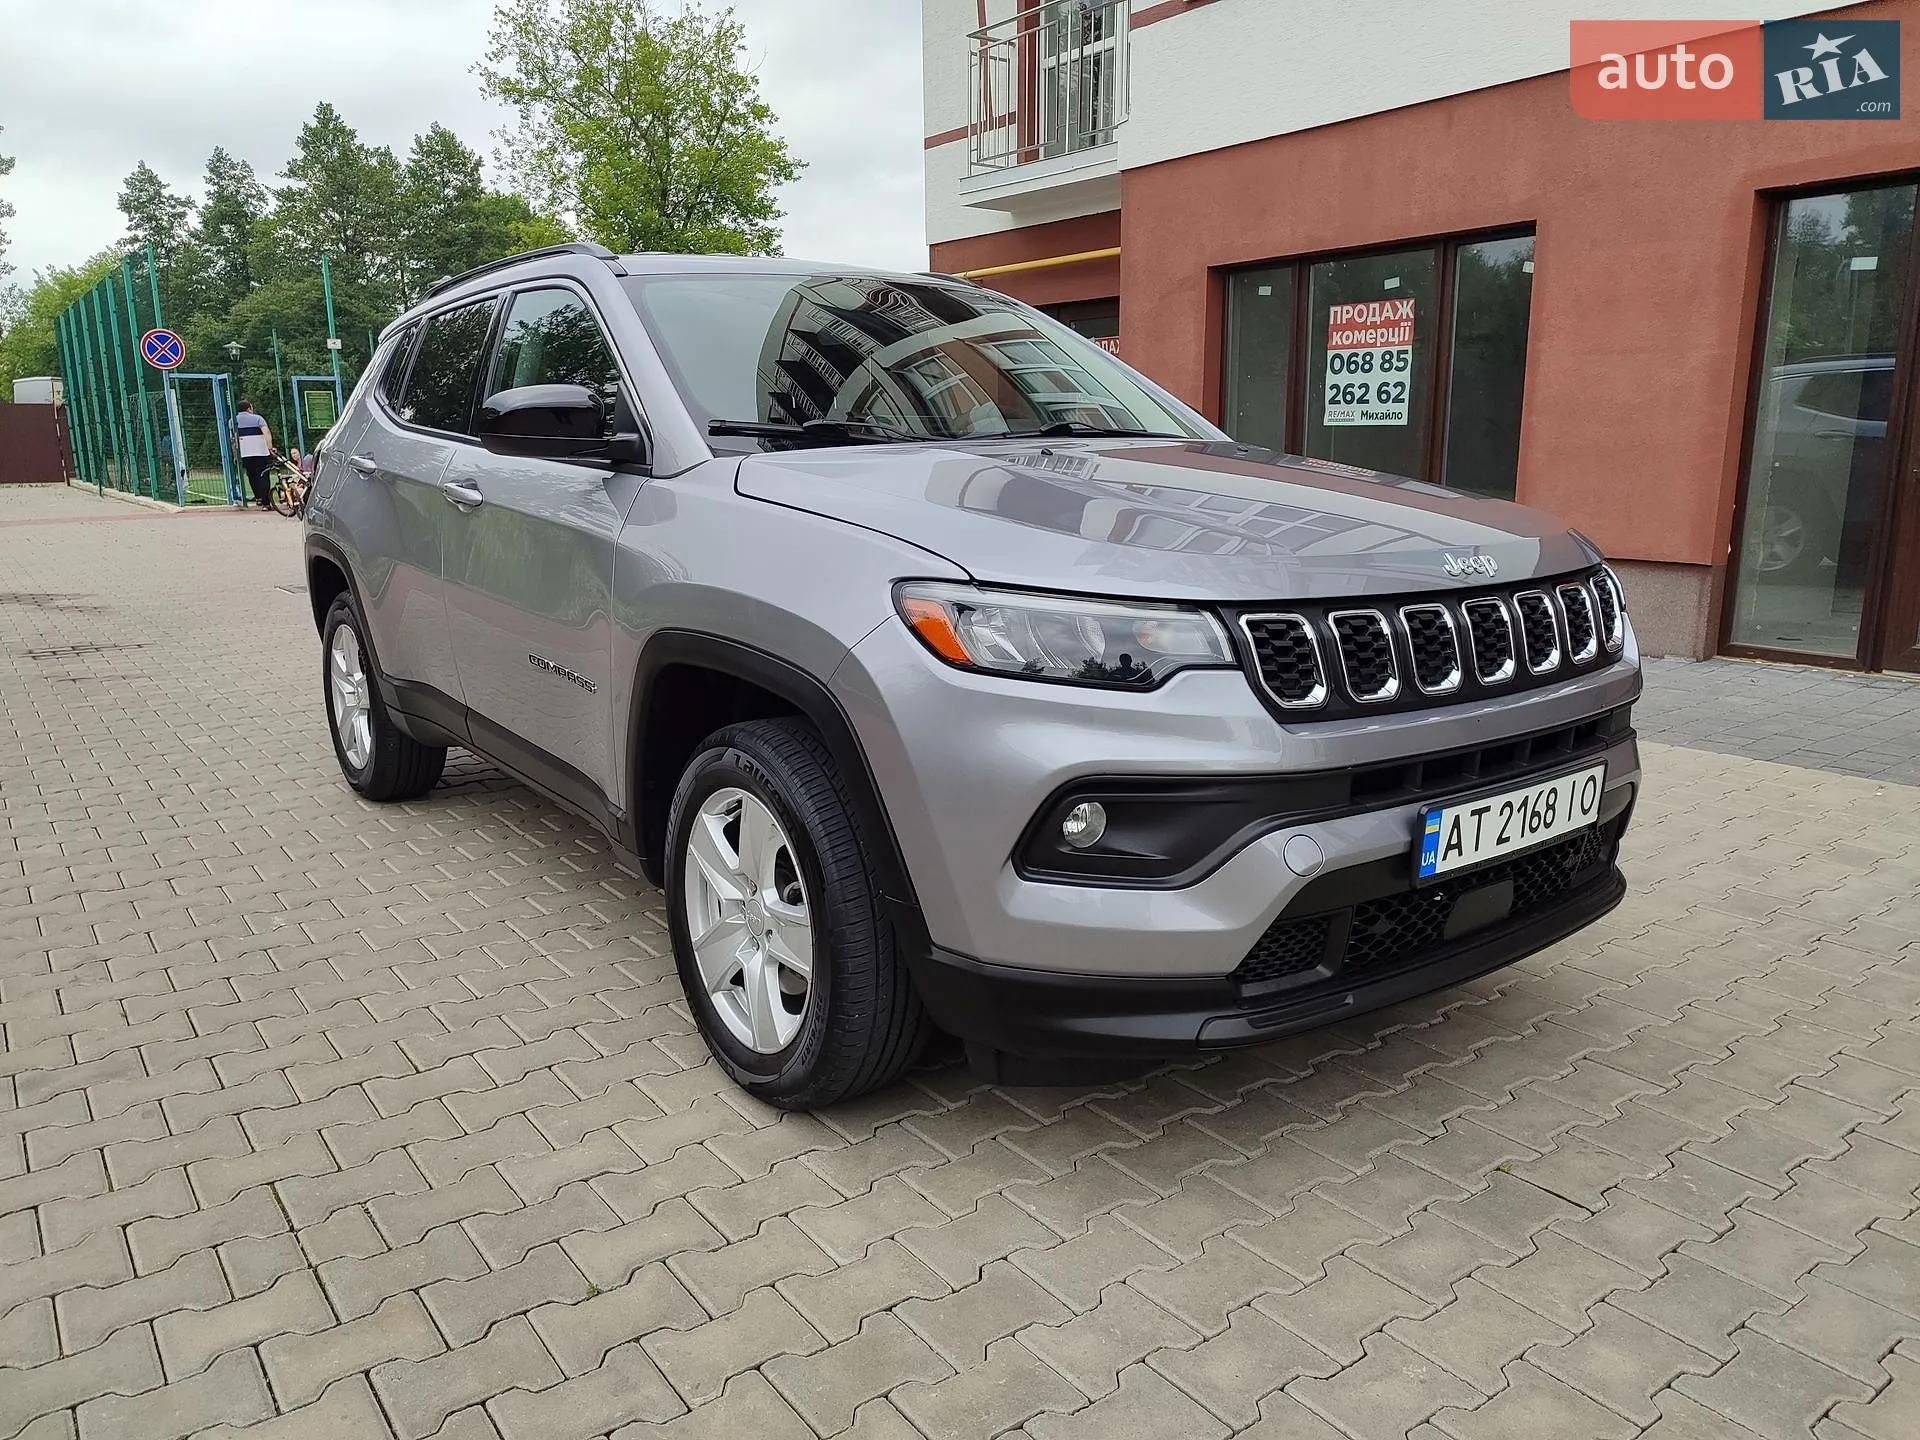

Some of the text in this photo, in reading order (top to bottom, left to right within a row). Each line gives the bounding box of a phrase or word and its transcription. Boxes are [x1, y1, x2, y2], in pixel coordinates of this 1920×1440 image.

[1329, 299, 1415, 325] ПРОДАЖ
[1331, 321, 1412, 347] комерції
[1329, 350, 1409, 375] 068 85
[1328, 381, 1407, 405] 262 62
[1360, 409, 1403, 421] Михайло
[1443, 552, 1498, 577] Jeep
[528, 652, 598, 694] COMPASS
[1441, 774, 1597, 861] AT 2168 IO
[1421, 851, 1436, 867] UA
